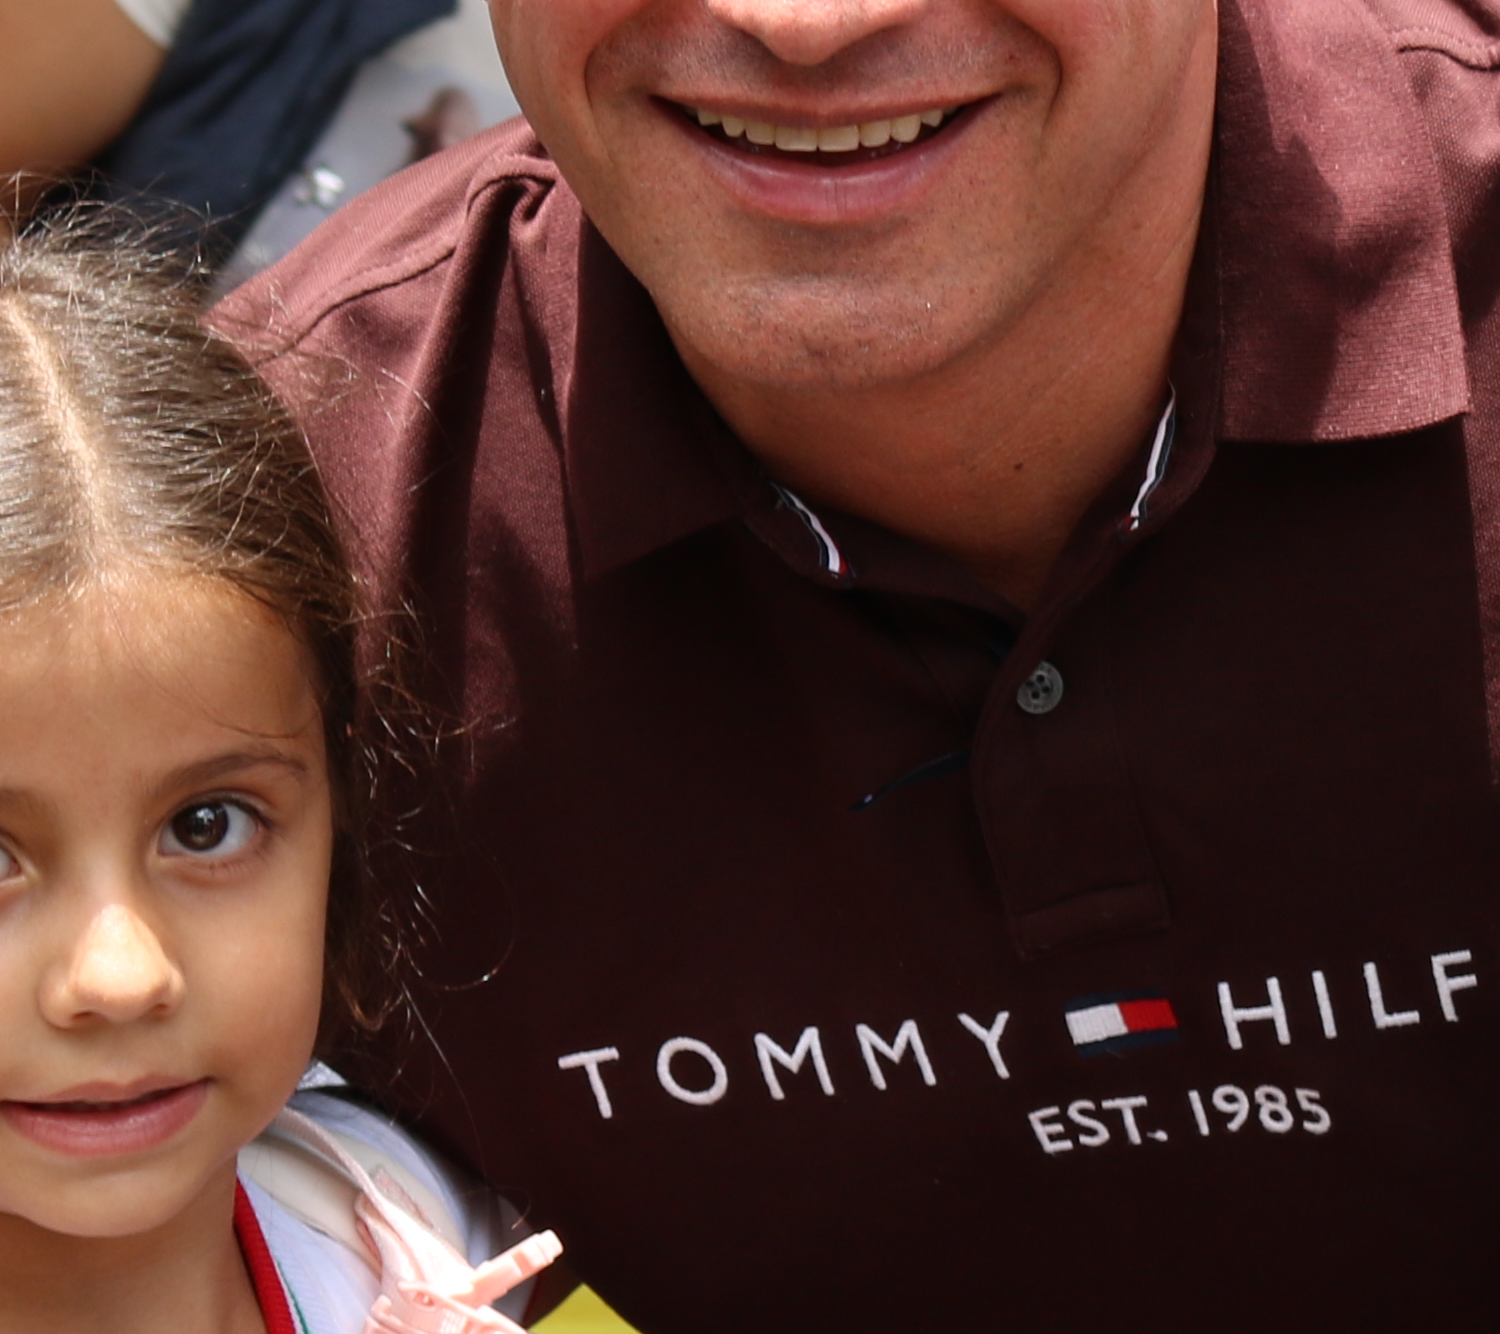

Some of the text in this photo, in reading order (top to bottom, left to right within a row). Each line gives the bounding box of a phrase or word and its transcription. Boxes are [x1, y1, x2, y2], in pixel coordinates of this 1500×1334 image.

[558, 1009, 1012, 1120] TOMMY
[1027, 1084, 1332, 1156] EST. 1985
